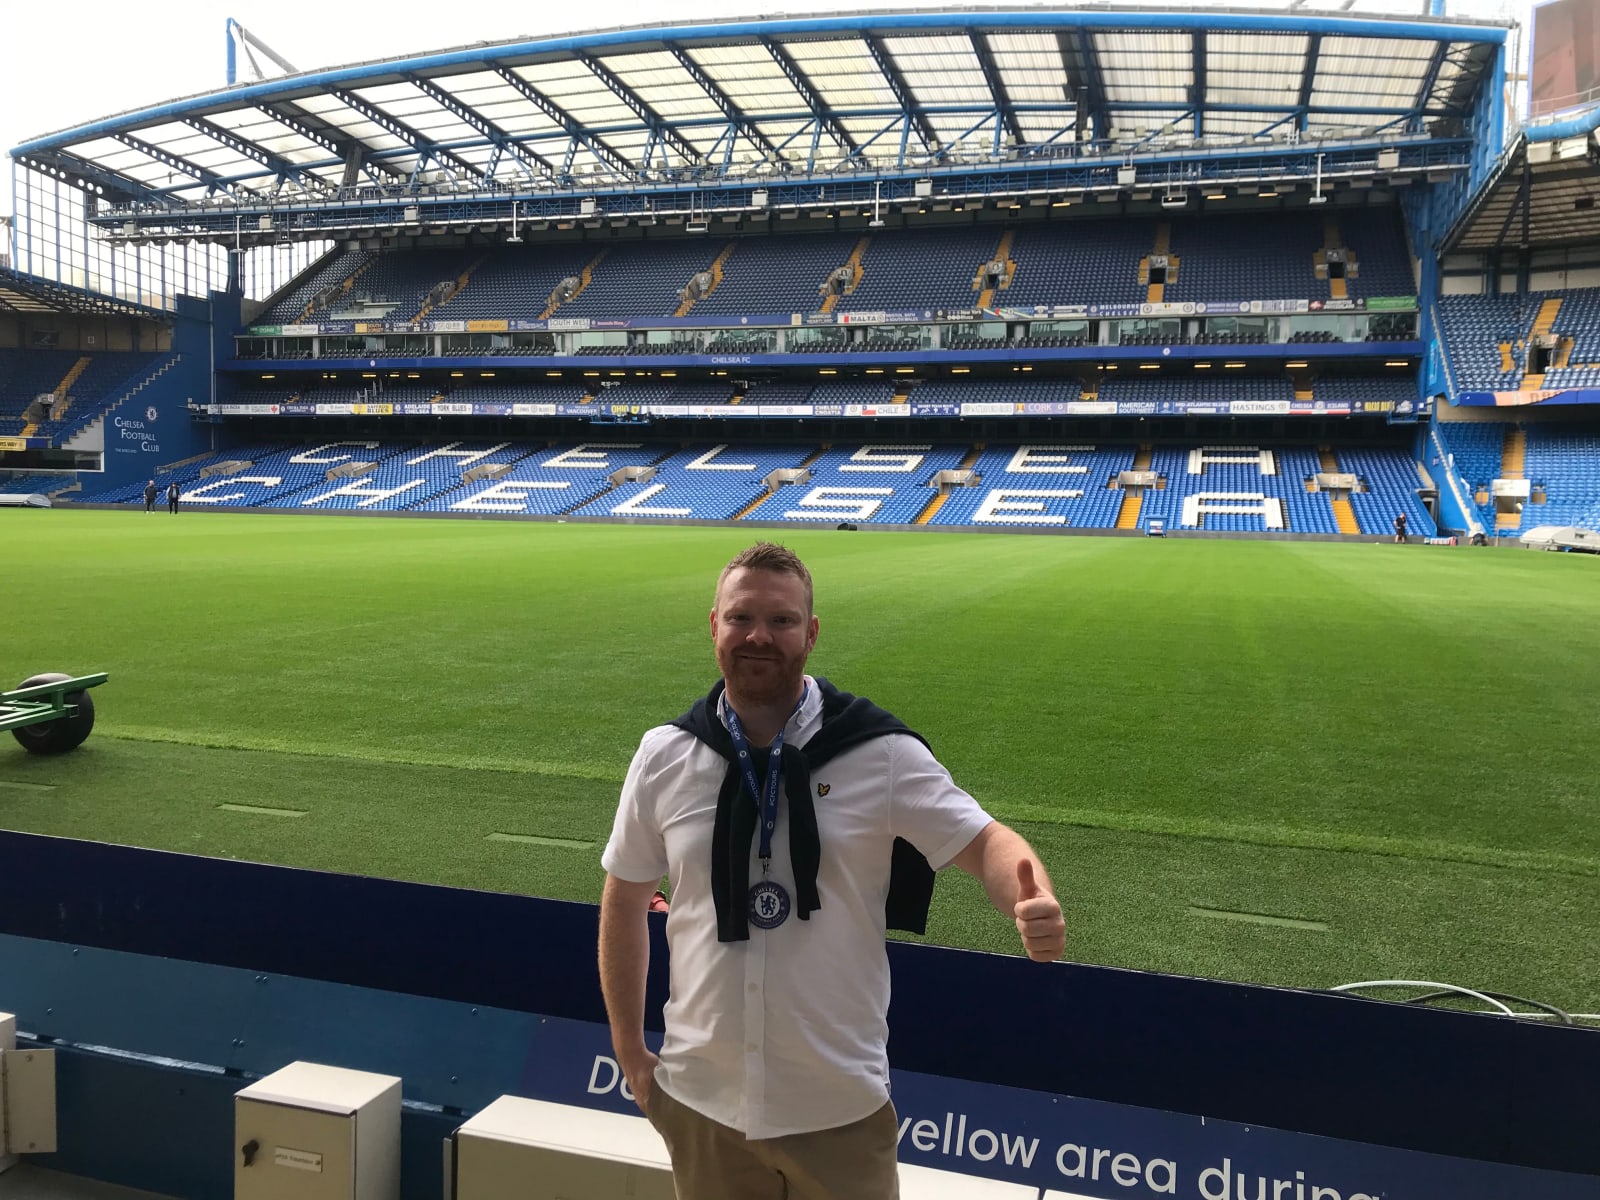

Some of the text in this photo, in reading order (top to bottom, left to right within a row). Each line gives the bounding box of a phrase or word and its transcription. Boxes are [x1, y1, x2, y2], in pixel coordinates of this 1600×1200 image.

[711, 356, 751, 364] CHELSEA FC
[610, 404, 630, 414] OHIO
[877, 405, 898, 414] CHILE
[1028, 403, 1053, 411] CORK
[1233, 403, 1275, 411] HASTINGS
[114, 416, 145, 429] CHELSEA
[121, 429, 156, 442] FOOTBALL
[141, 441, 160, 452] CLUB
[769, 769, 778, 807] #CFCTOURS
[1055, 1142, 1178, 1195] area
[1197, 1157, 1381, 1200] duri
